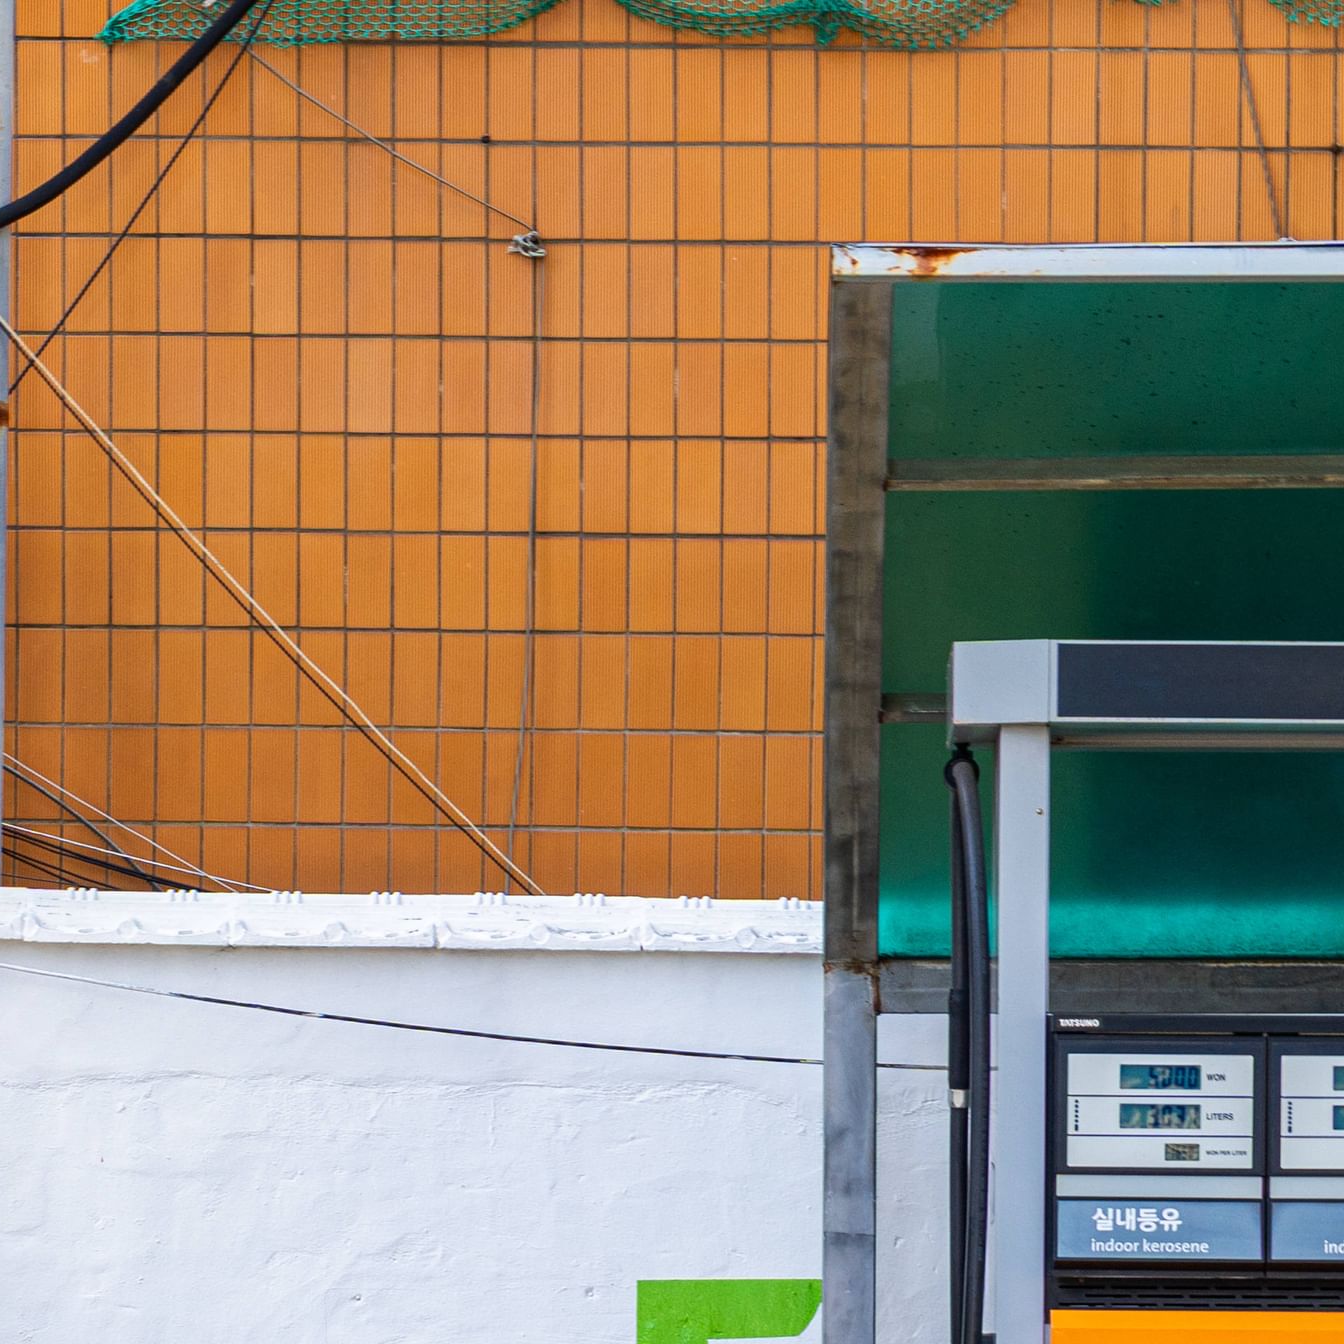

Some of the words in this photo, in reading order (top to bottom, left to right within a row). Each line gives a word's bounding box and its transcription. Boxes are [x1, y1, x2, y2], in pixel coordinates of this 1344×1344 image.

[1058, 1018, 1101, 1028] TATSUNO
[1206, 1073, 1227, 1082] WON
[1206, 1113, 1234, 1121] LITERS
[1091, 1208, 1183, 1232] 실내등유
[1090, 1238, 1139, 1254] indoor
[1142, 1238, 1210, 1254] kerosene
